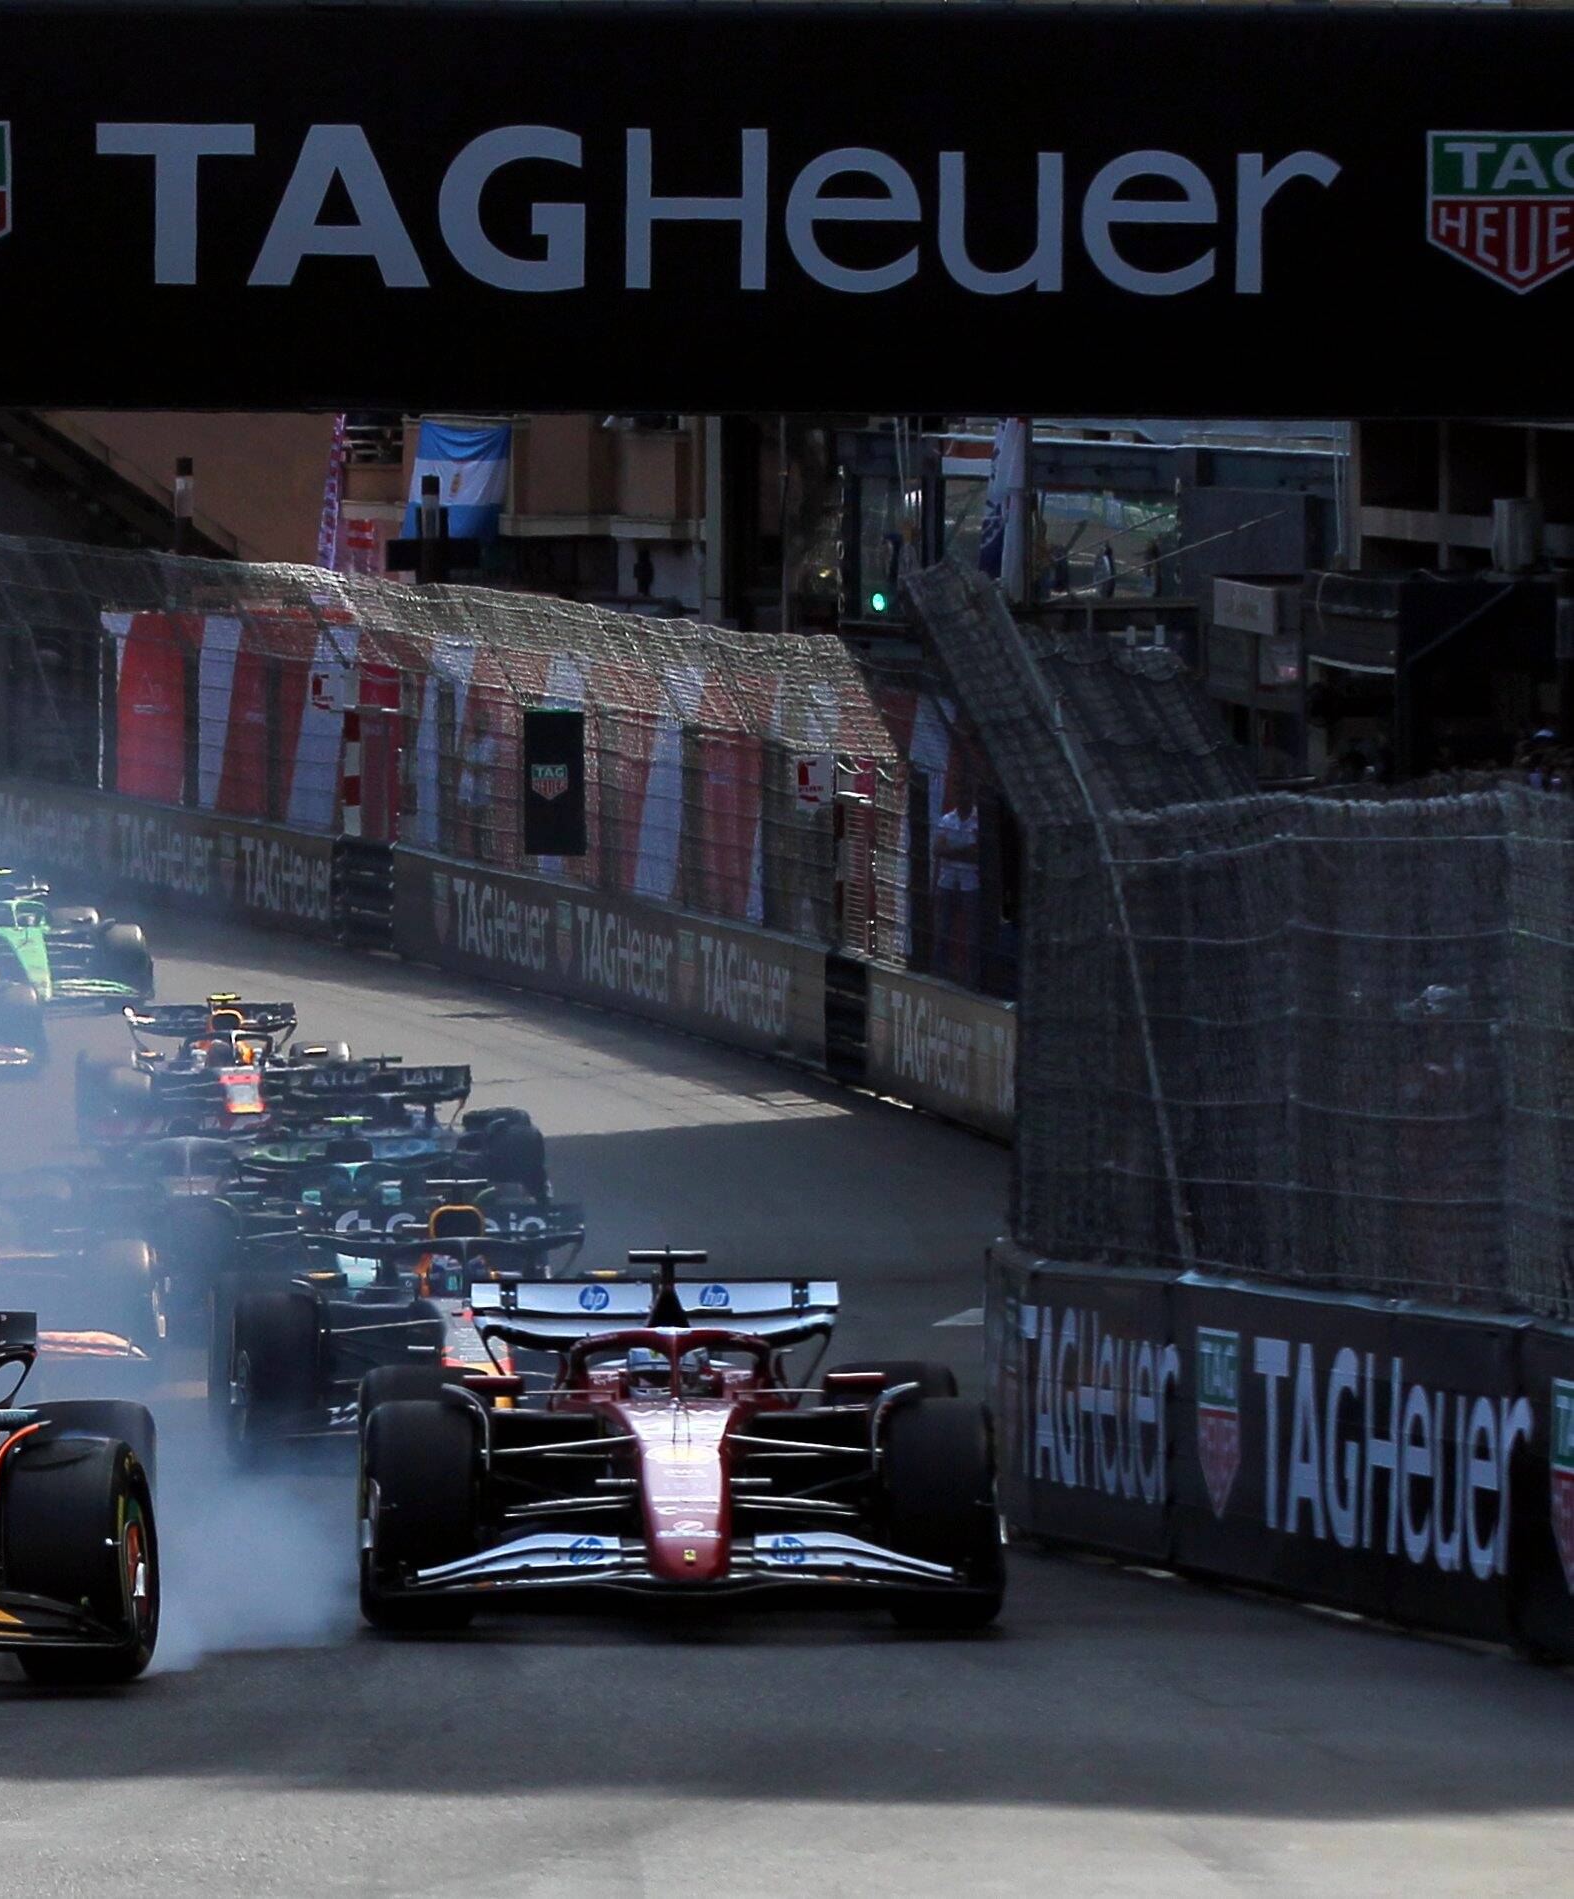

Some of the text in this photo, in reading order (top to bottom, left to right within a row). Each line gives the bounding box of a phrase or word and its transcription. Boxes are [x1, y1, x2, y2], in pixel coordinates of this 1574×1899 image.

[1438, 206, 1574, 282] HEUE
[580, 1286, 609, 1311] hp
[700, 1285, 729, 1308] hp
